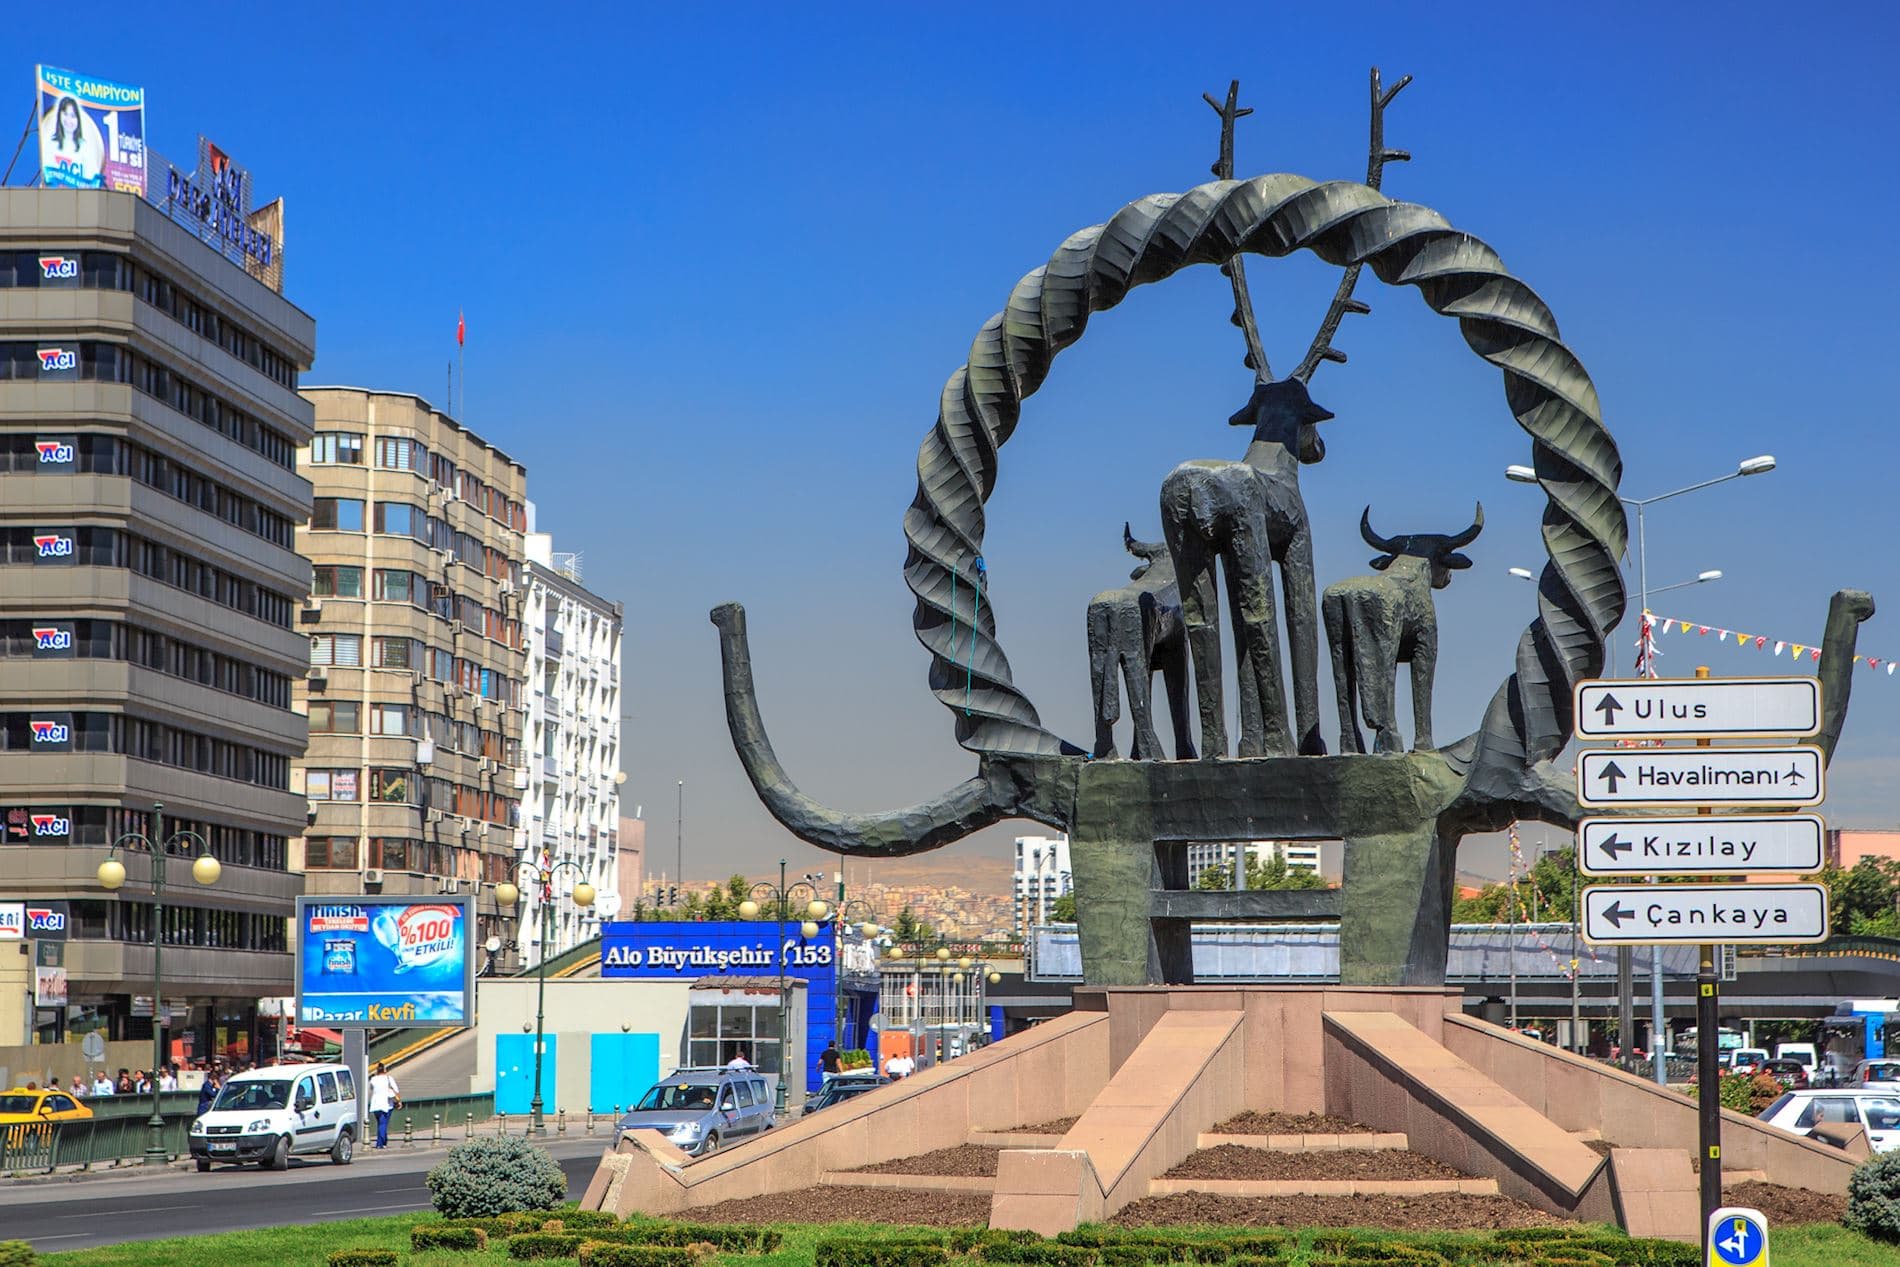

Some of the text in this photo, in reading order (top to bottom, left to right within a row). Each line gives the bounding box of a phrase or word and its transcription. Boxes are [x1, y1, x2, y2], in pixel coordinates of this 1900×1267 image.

[46, 260, 77, 277] ACI
[44, 352, 75, 370] ACI
[41, 446, 72, 463] ACI
[40, 539, 72, 556] ACI
[38, 632, 70, 649] ACI
[1634, 699, 1707, 719] Ulus
[35, 725, 67, 742] ACI
[1637, 765, 1779, 786] Havalimanı
[36, 818, 69, 835] ACI
[1643, 836, 1757, 861] Kızılay
[31, 914, 64, 930] ACI
[1647, 903, 1788, 928] Çankaya
[400, 919, 450, 945] %100
[415, 937, 454, 956] ETKİLİ!
[605, 943, 832, 970] Alo Büyükşehir 153
